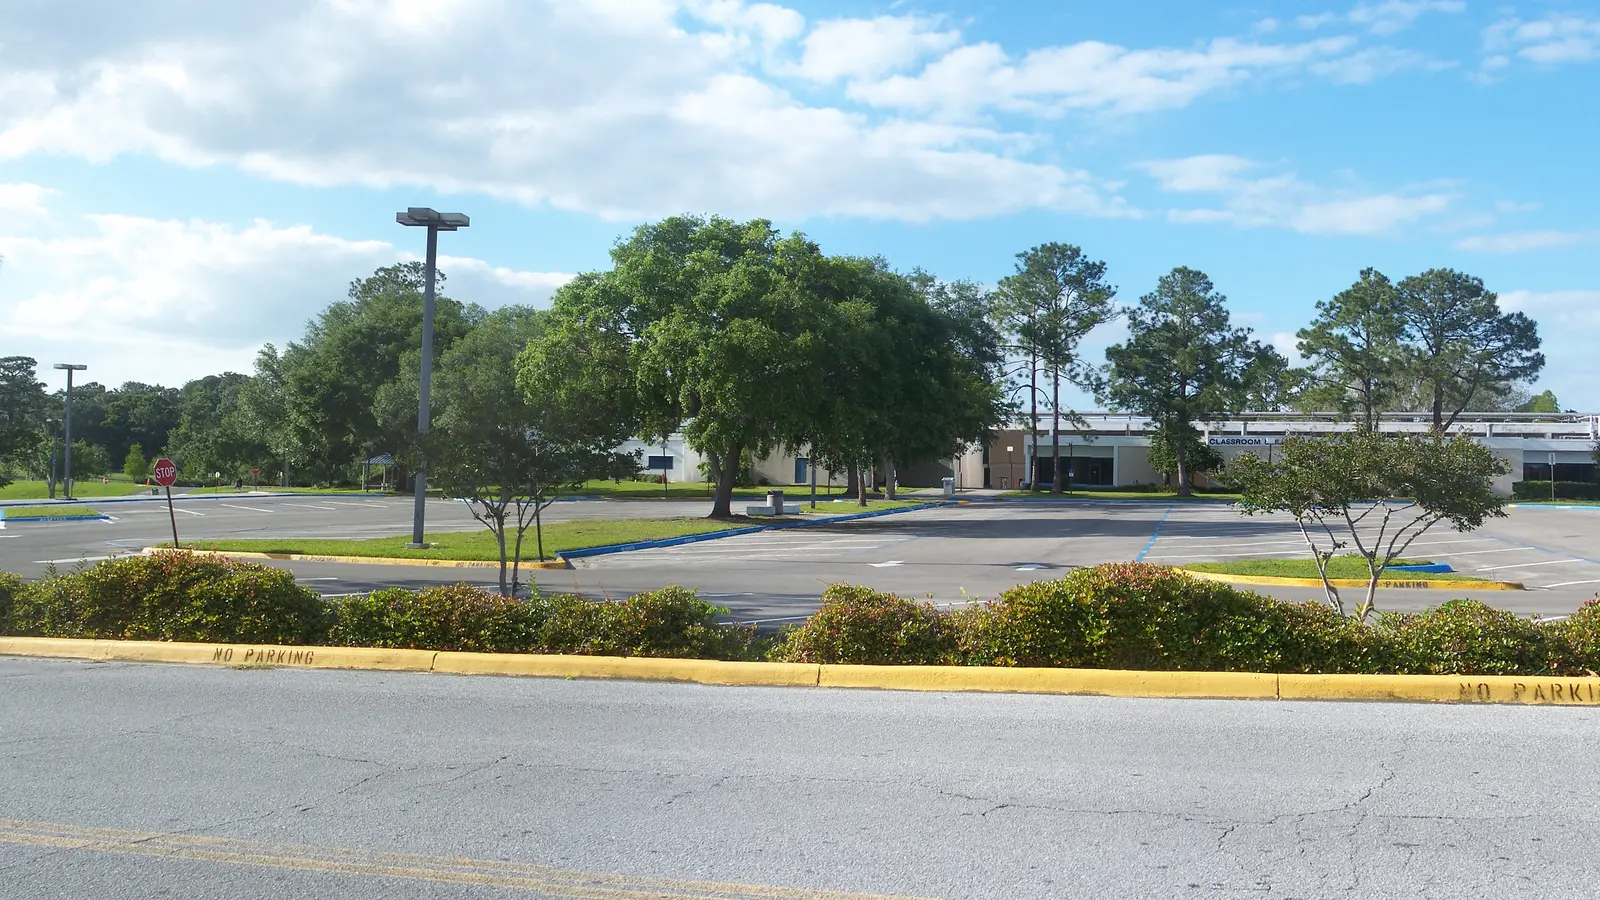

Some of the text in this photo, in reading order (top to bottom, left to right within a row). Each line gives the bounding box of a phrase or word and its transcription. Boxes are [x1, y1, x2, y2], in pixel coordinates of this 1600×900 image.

[1209, 438, 1261, 446] CLASSROOM
[155, 466, 175, 478] STOP
[1385, 581, 1428, 589] PARKING
[213, 647, 315, 665] NO PARKING
[1460, 682, 1600, 701] NO PARKI
